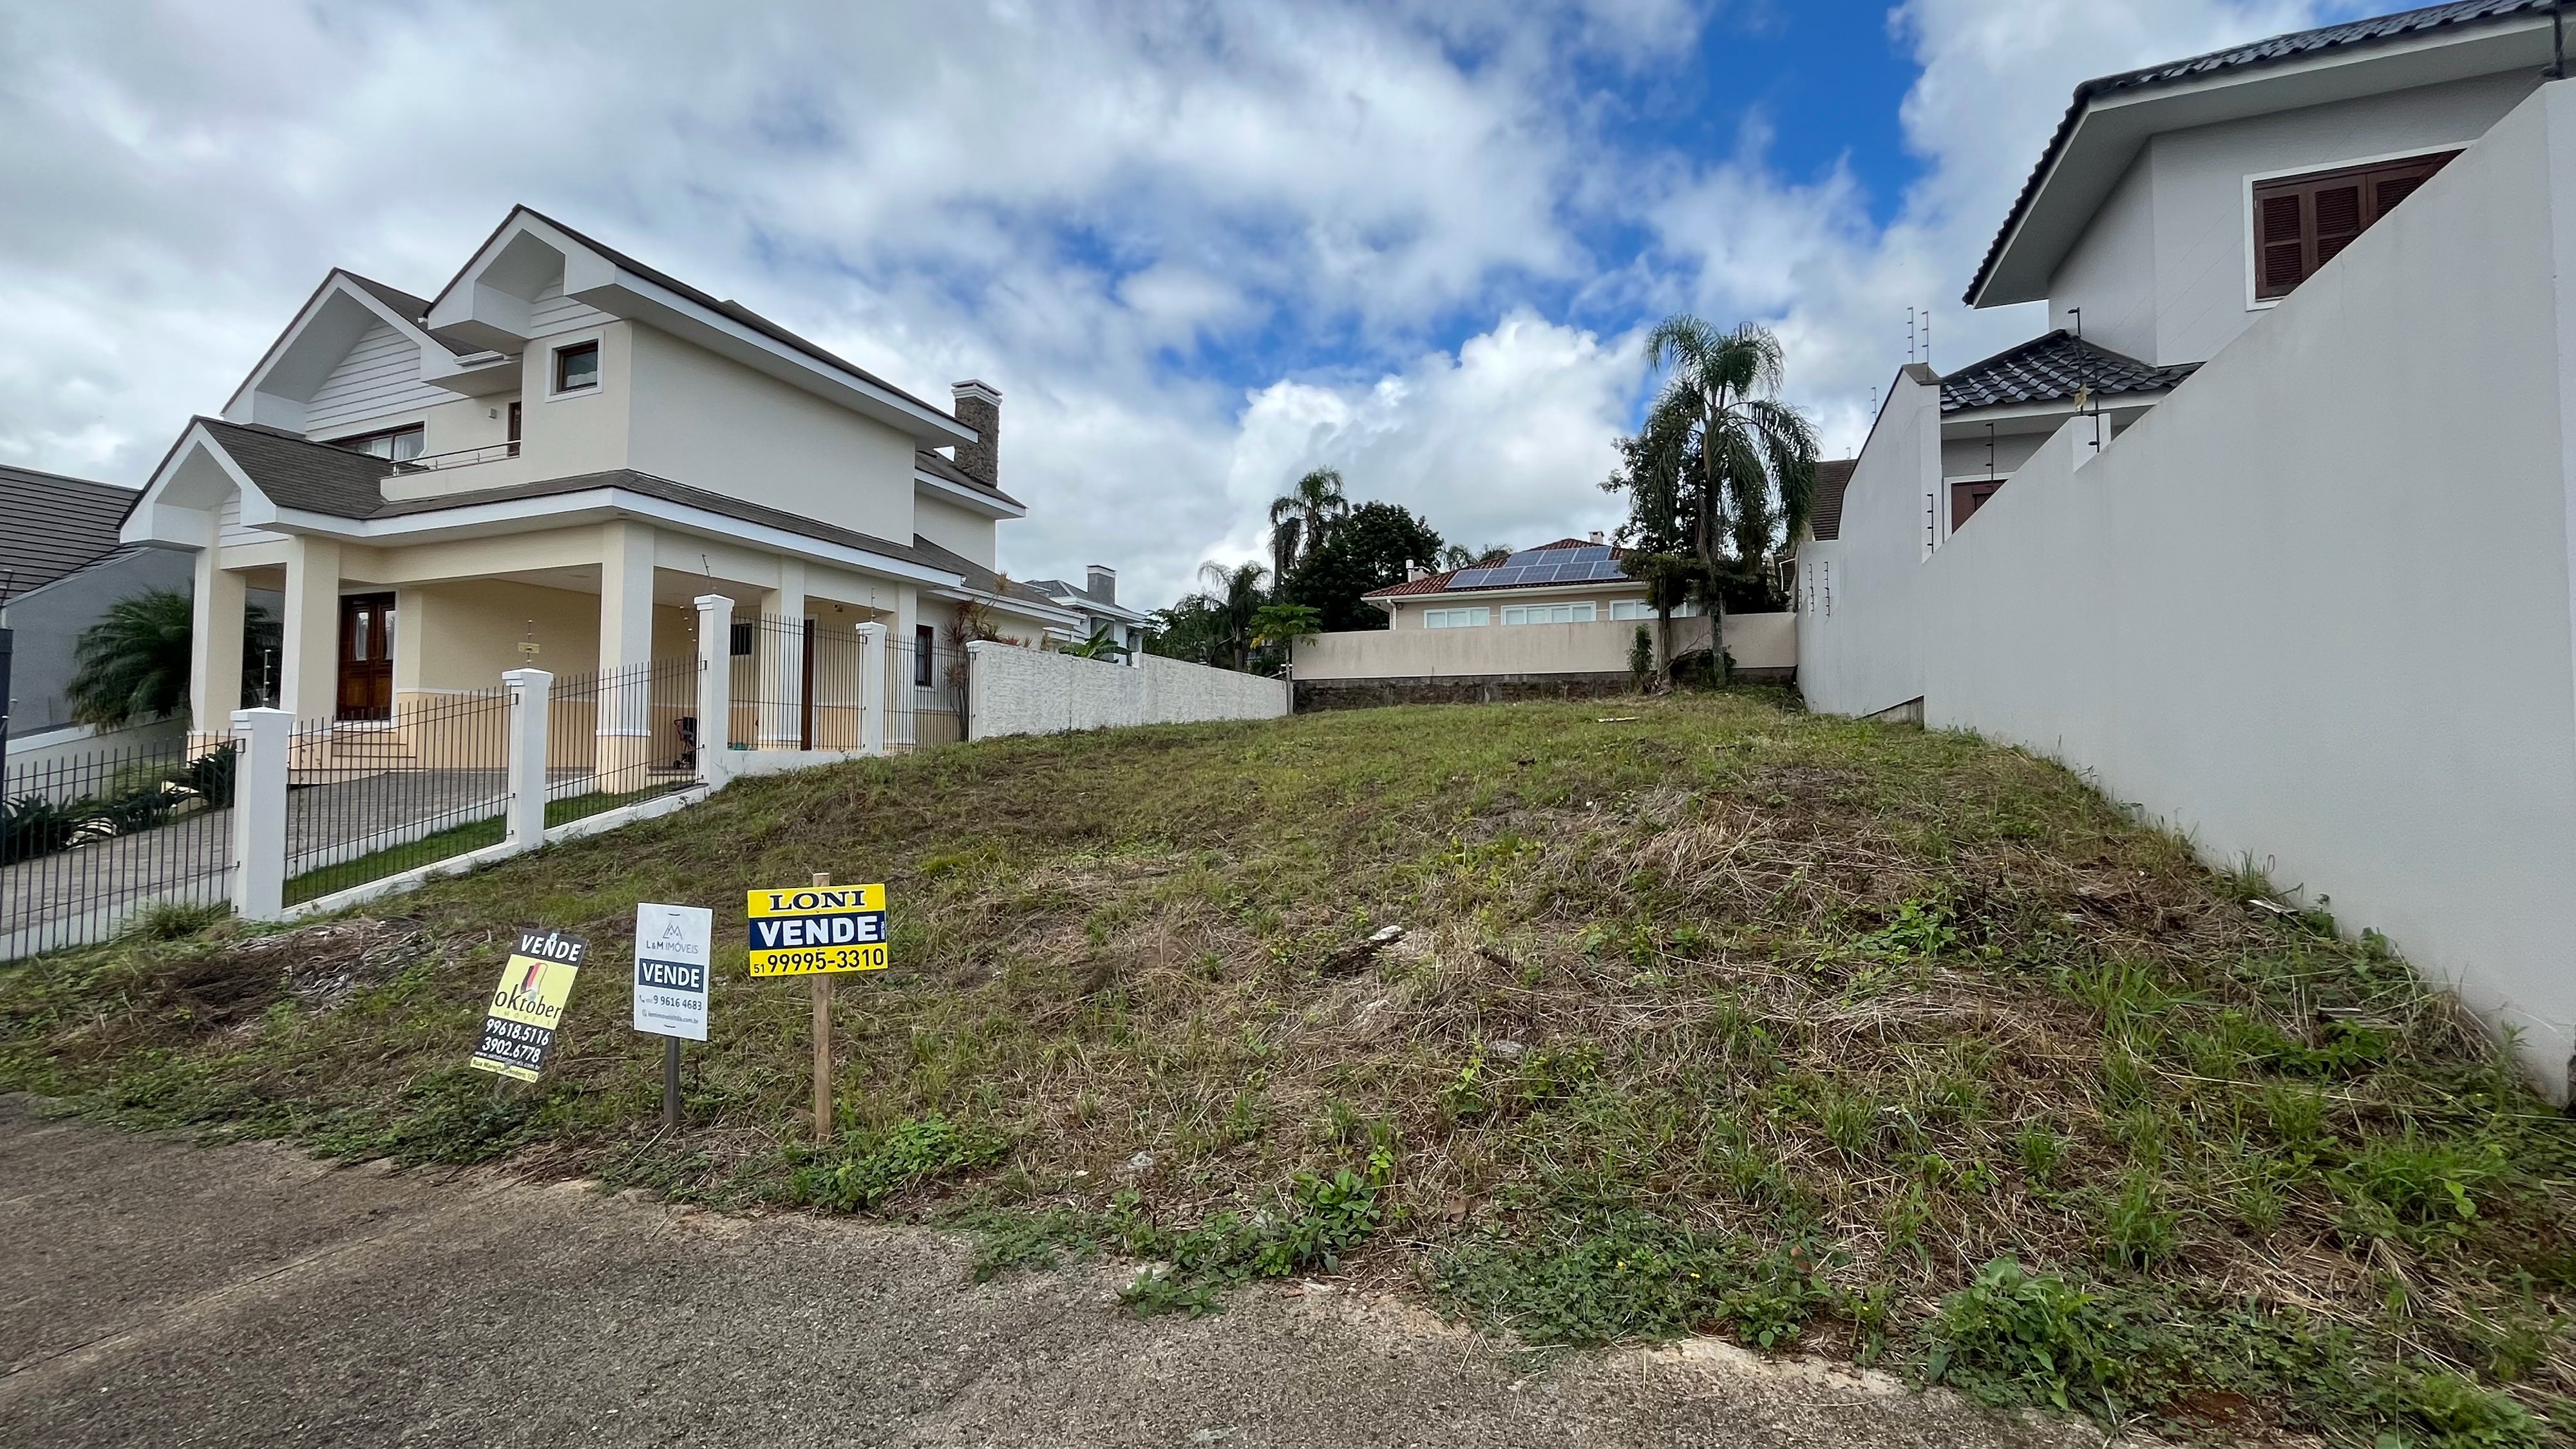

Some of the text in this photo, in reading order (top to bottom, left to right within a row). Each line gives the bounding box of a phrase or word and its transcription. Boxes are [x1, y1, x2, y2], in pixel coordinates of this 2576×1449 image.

[770, 891, 865, 911] LONI
[757, 915, 878, 947] VENDE
[521, 934, 582, 961] VENDE
[646, 940, 698, 954] L&M IMÓVEIS
[753, 948, 884, 973] 51 99995-3310
[642, 962, 700, 988] VENDE
[495, 983, 562, 1019] oktober
[653, 995, 658, 1004] 9
[661, 996, 680, 1008] 9616
[682, 999, 702, 1010] 4683
[497, 1009, 551, 1026] IMÓVEIS
[485, 1018, 550, 1046] 99618.5116
[482, 1036, 541, 1063] 3902.6778
